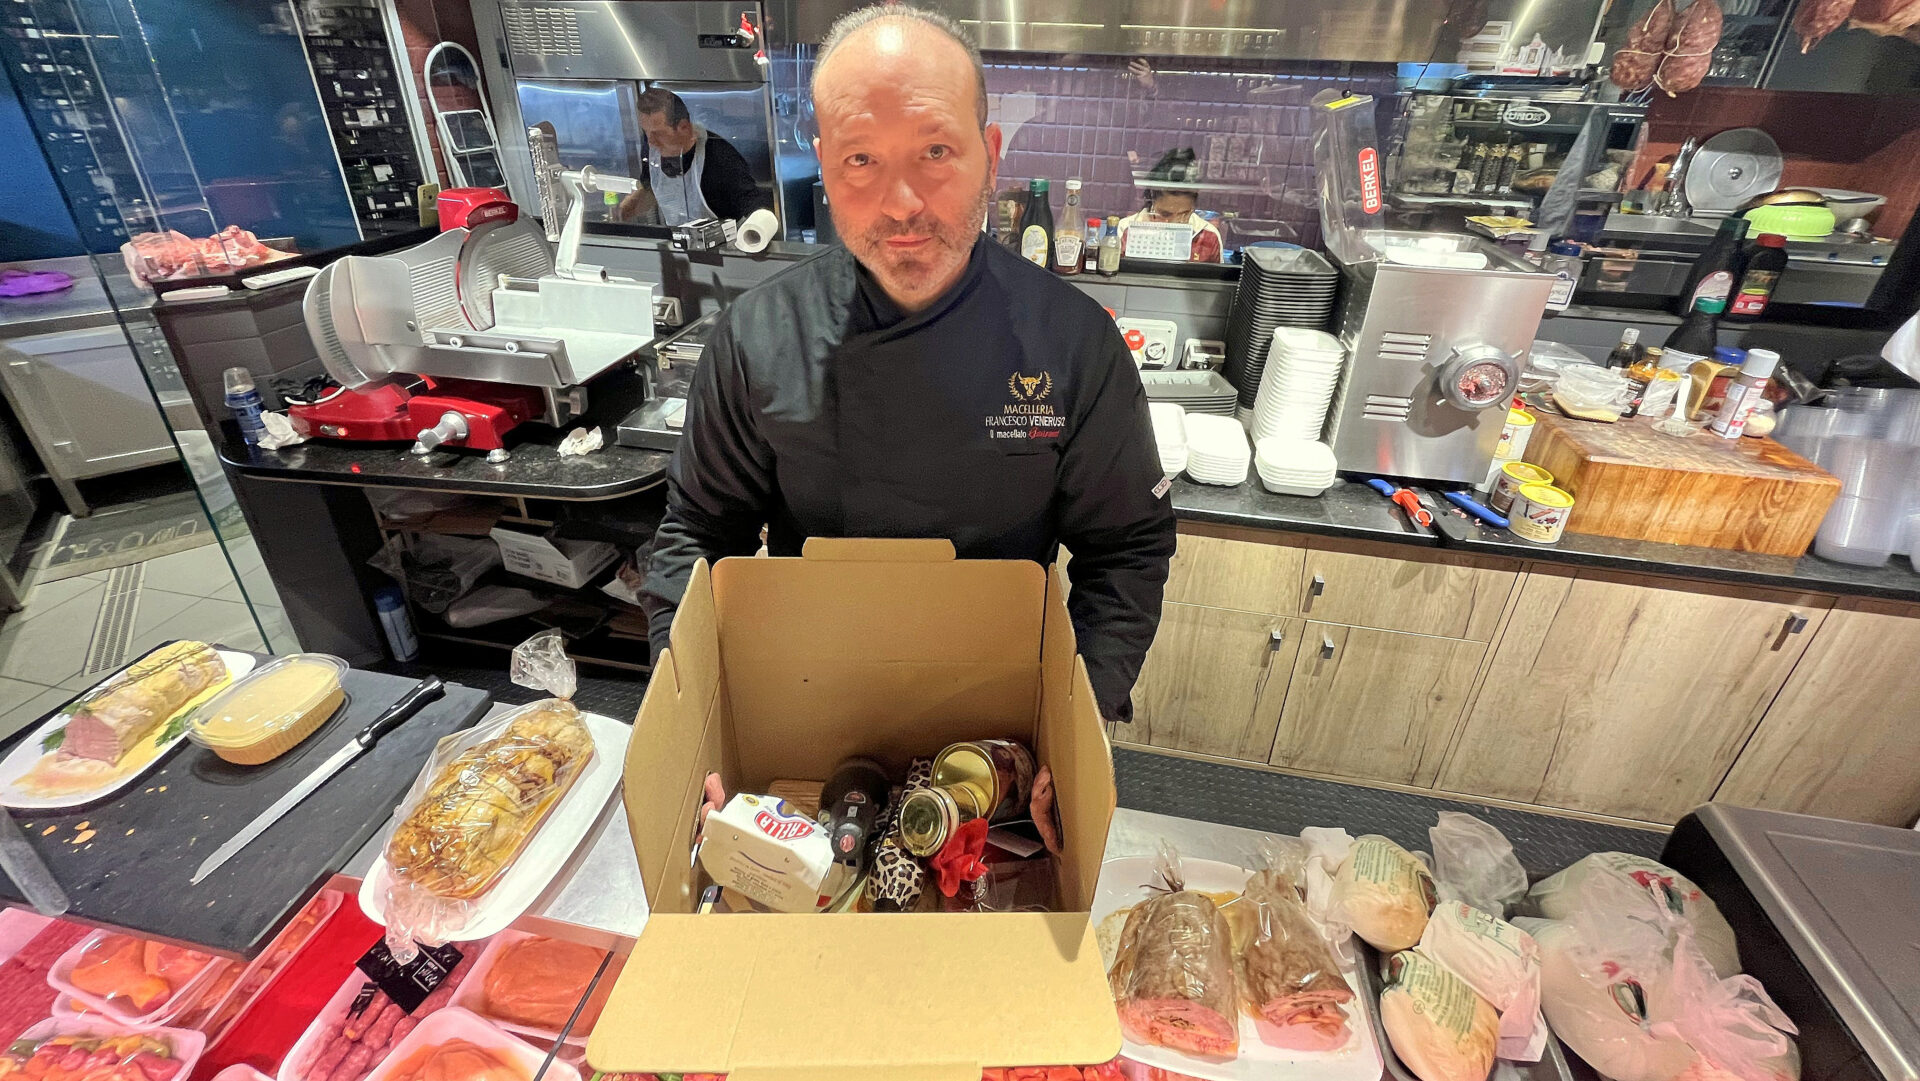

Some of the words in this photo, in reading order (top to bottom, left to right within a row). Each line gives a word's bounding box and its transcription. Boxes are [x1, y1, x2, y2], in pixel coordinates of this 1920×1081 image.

[1362, 153, 1378, 209] BERKEL
[1003, 404, 1054, 415] MACELLERIA
[985, 416, 1027, 426] FRANCESCO
[759, 815, 810, 840] FAELLA
